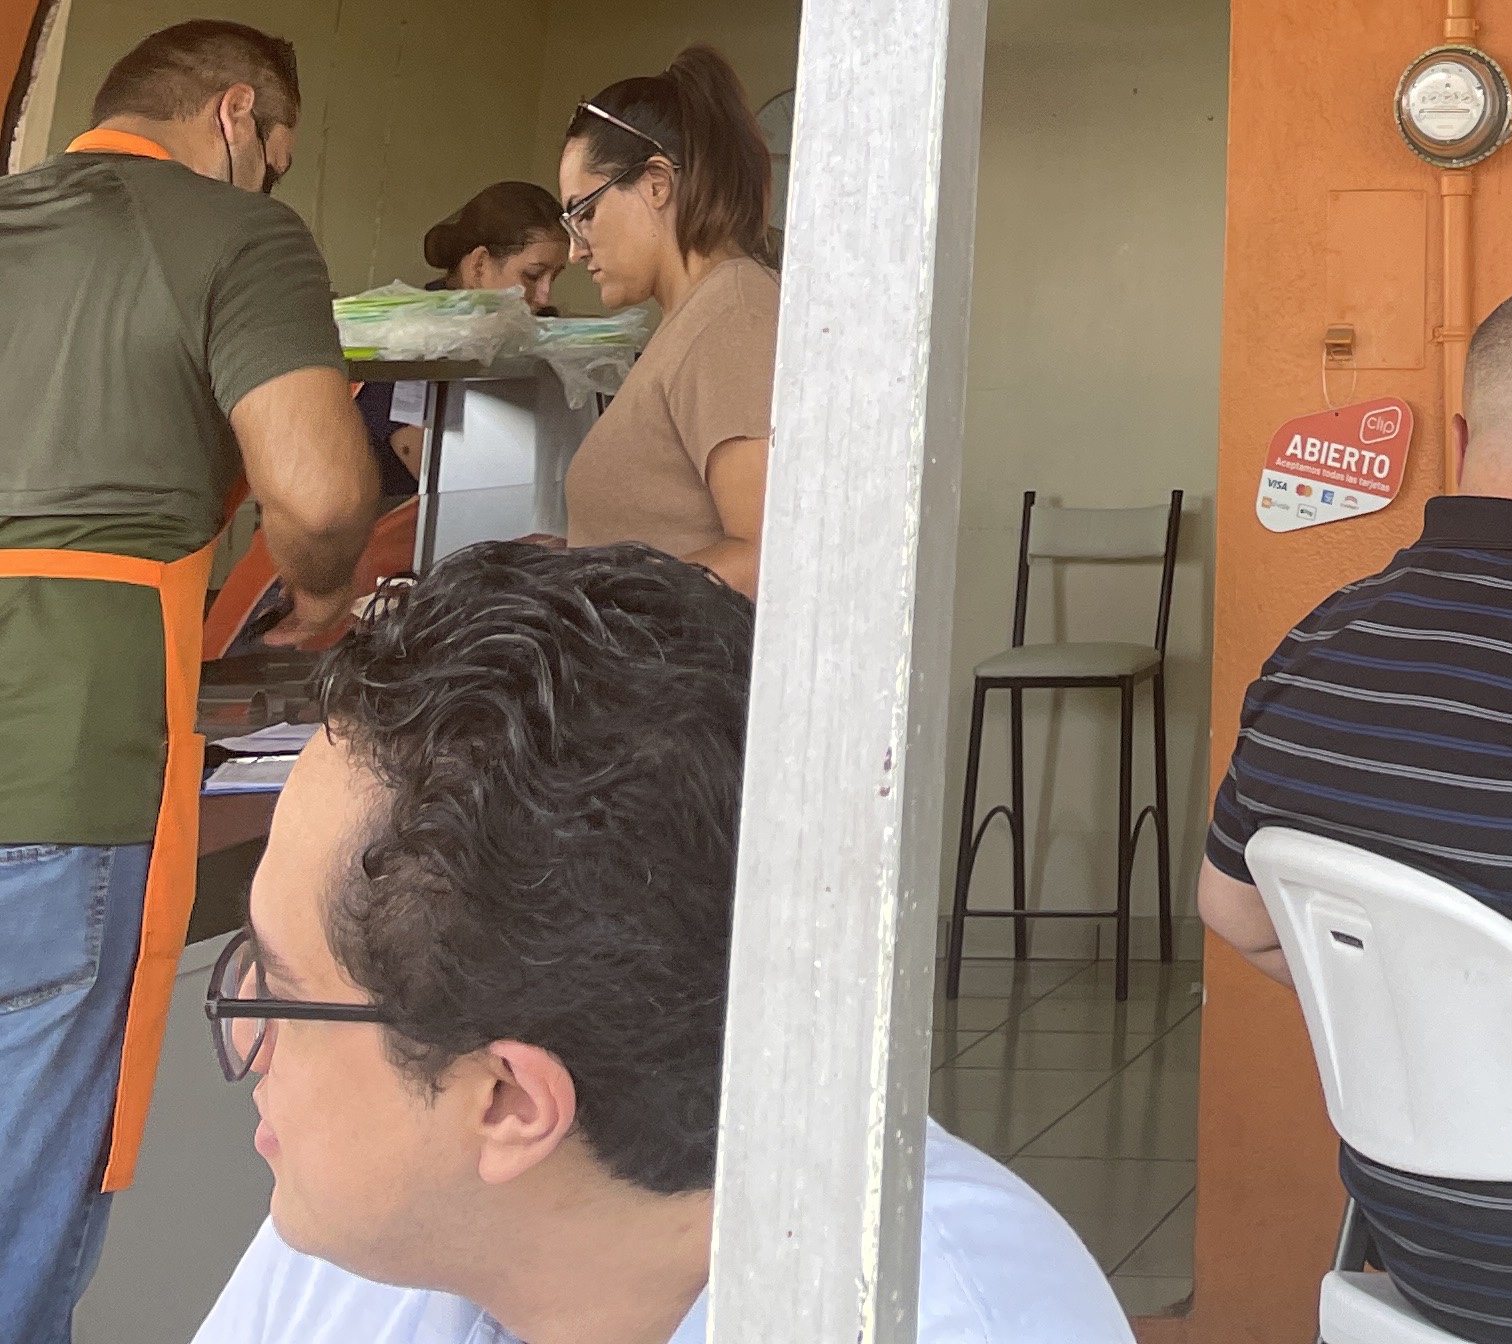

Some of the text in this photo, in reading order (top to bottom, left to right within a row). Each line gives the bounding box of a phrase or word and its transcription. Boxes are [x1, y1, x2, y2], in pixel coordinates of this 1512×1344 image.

[1366, 416, 1395, 434] clip
[1285, 434, 1391, 478] ABIERTO
[1267, 478, 1288, 492] VISA
